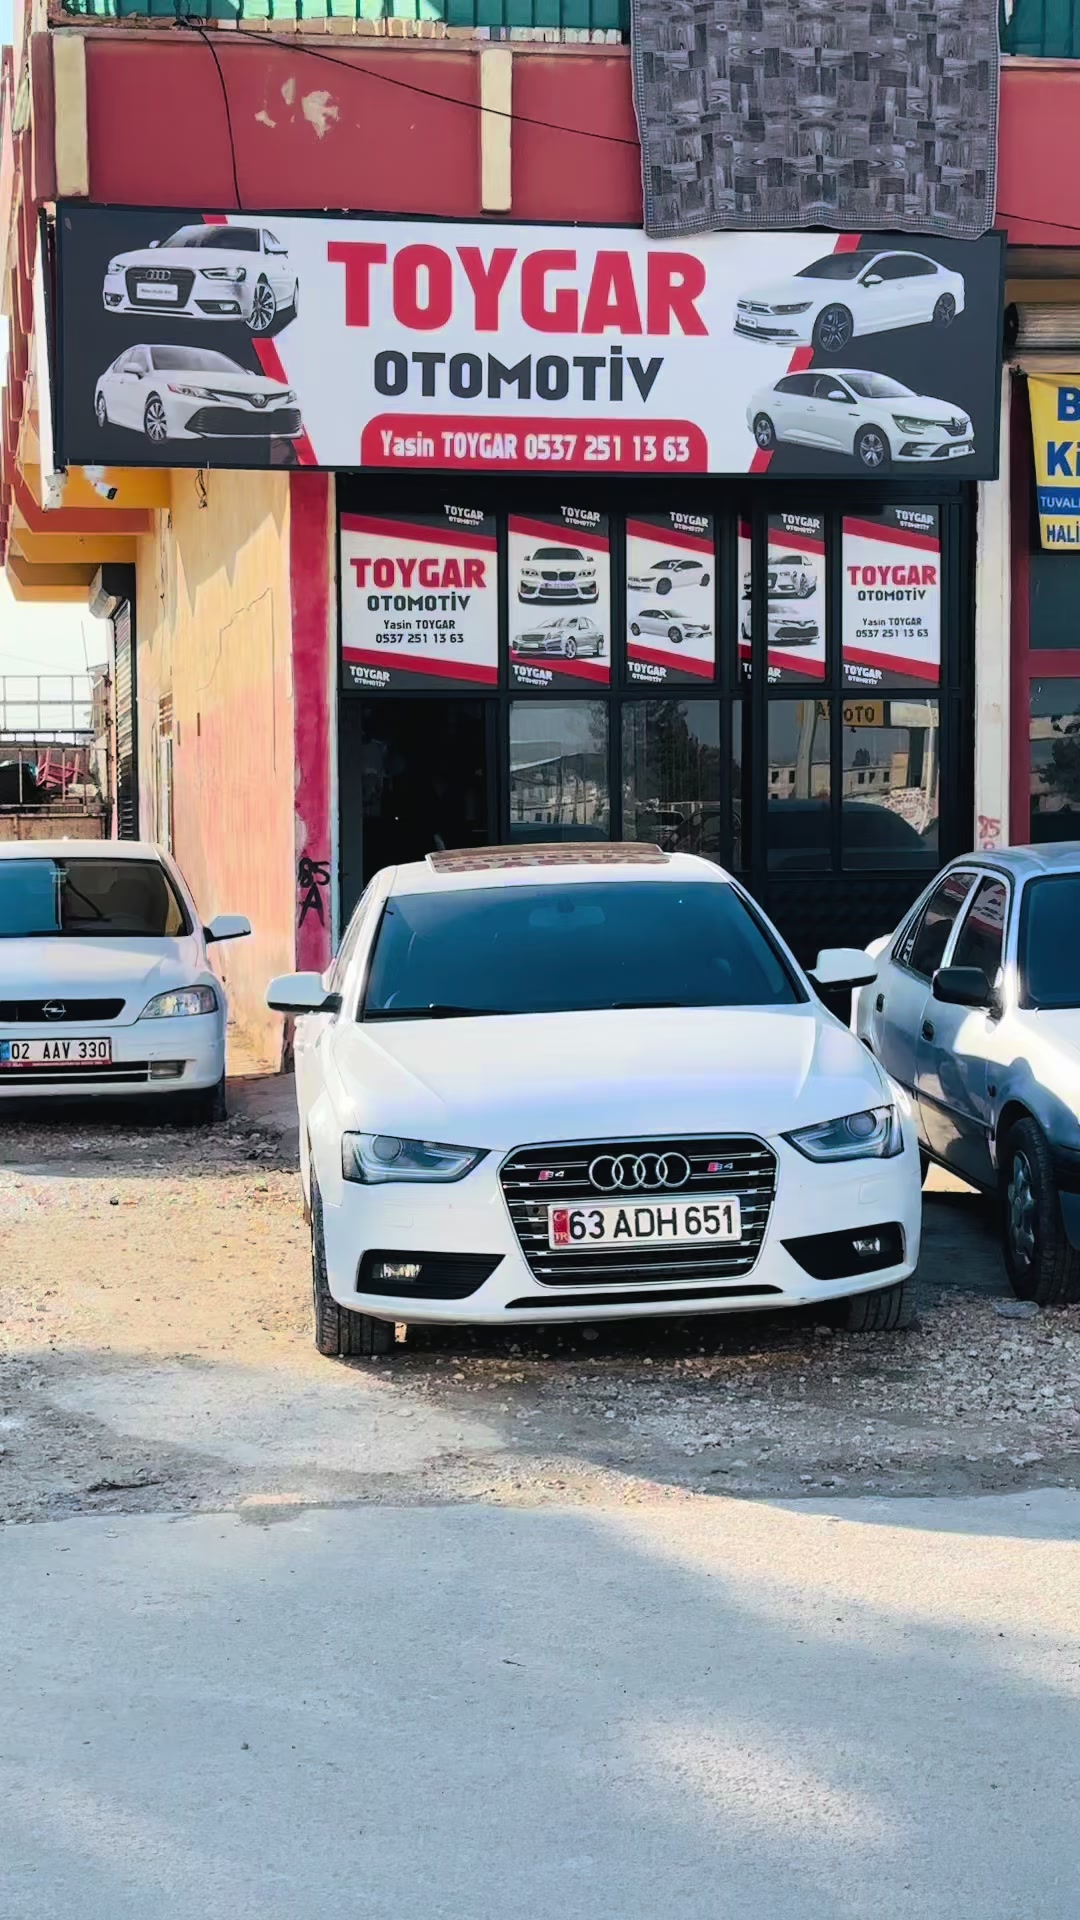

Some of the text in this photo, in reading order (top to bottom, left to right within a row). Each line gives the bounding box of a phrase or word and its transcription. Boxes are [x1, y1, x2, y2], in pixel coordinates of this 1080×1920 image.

[327, 241, 709, 336] TOYGAR
[374, 345, 665, 403] OTOMOTİV
[381, 430, 690, 462] Yasin TOYGAR 0537 251 13 63
[1041, 496, 1080, 508] TUVAL
[444, 504, 484, 521] TOYGAR
[560, 505, 601, 522] TOYGAR
[669, 511, 708, 528] TOYGAR
[781, 513, 820, 529] TOYGAR
[895, 509, 934, 525] TOYGAR
[350, 558, 487, 588] TOYGAR
[847, 565, 937, 587] TOYGAR
[367, 591, 471, 611] OTOMOTİV
[857, 587, 927, 602] OTOMOTİV
[383, 619, 456, 630] Yasin TOYGAR
[862, 617, 922, 627] Yasin TOYGAR
[375, 633, 464, 644] 0537 251 13 63
[856, 628, 929, 639] 0537 251 13 63
[349, 665, 390, 682] TOYGAR
[512, 664, 553, 681] TOYGAR
[627, 661, 667, 678] TOYGAR
[843, 663, 883, 680] TOYGAR
[11, 1041, 107, 1060] 02 AAV 330
[554, 1204, 733, 1241] TR 63 ADH 651
